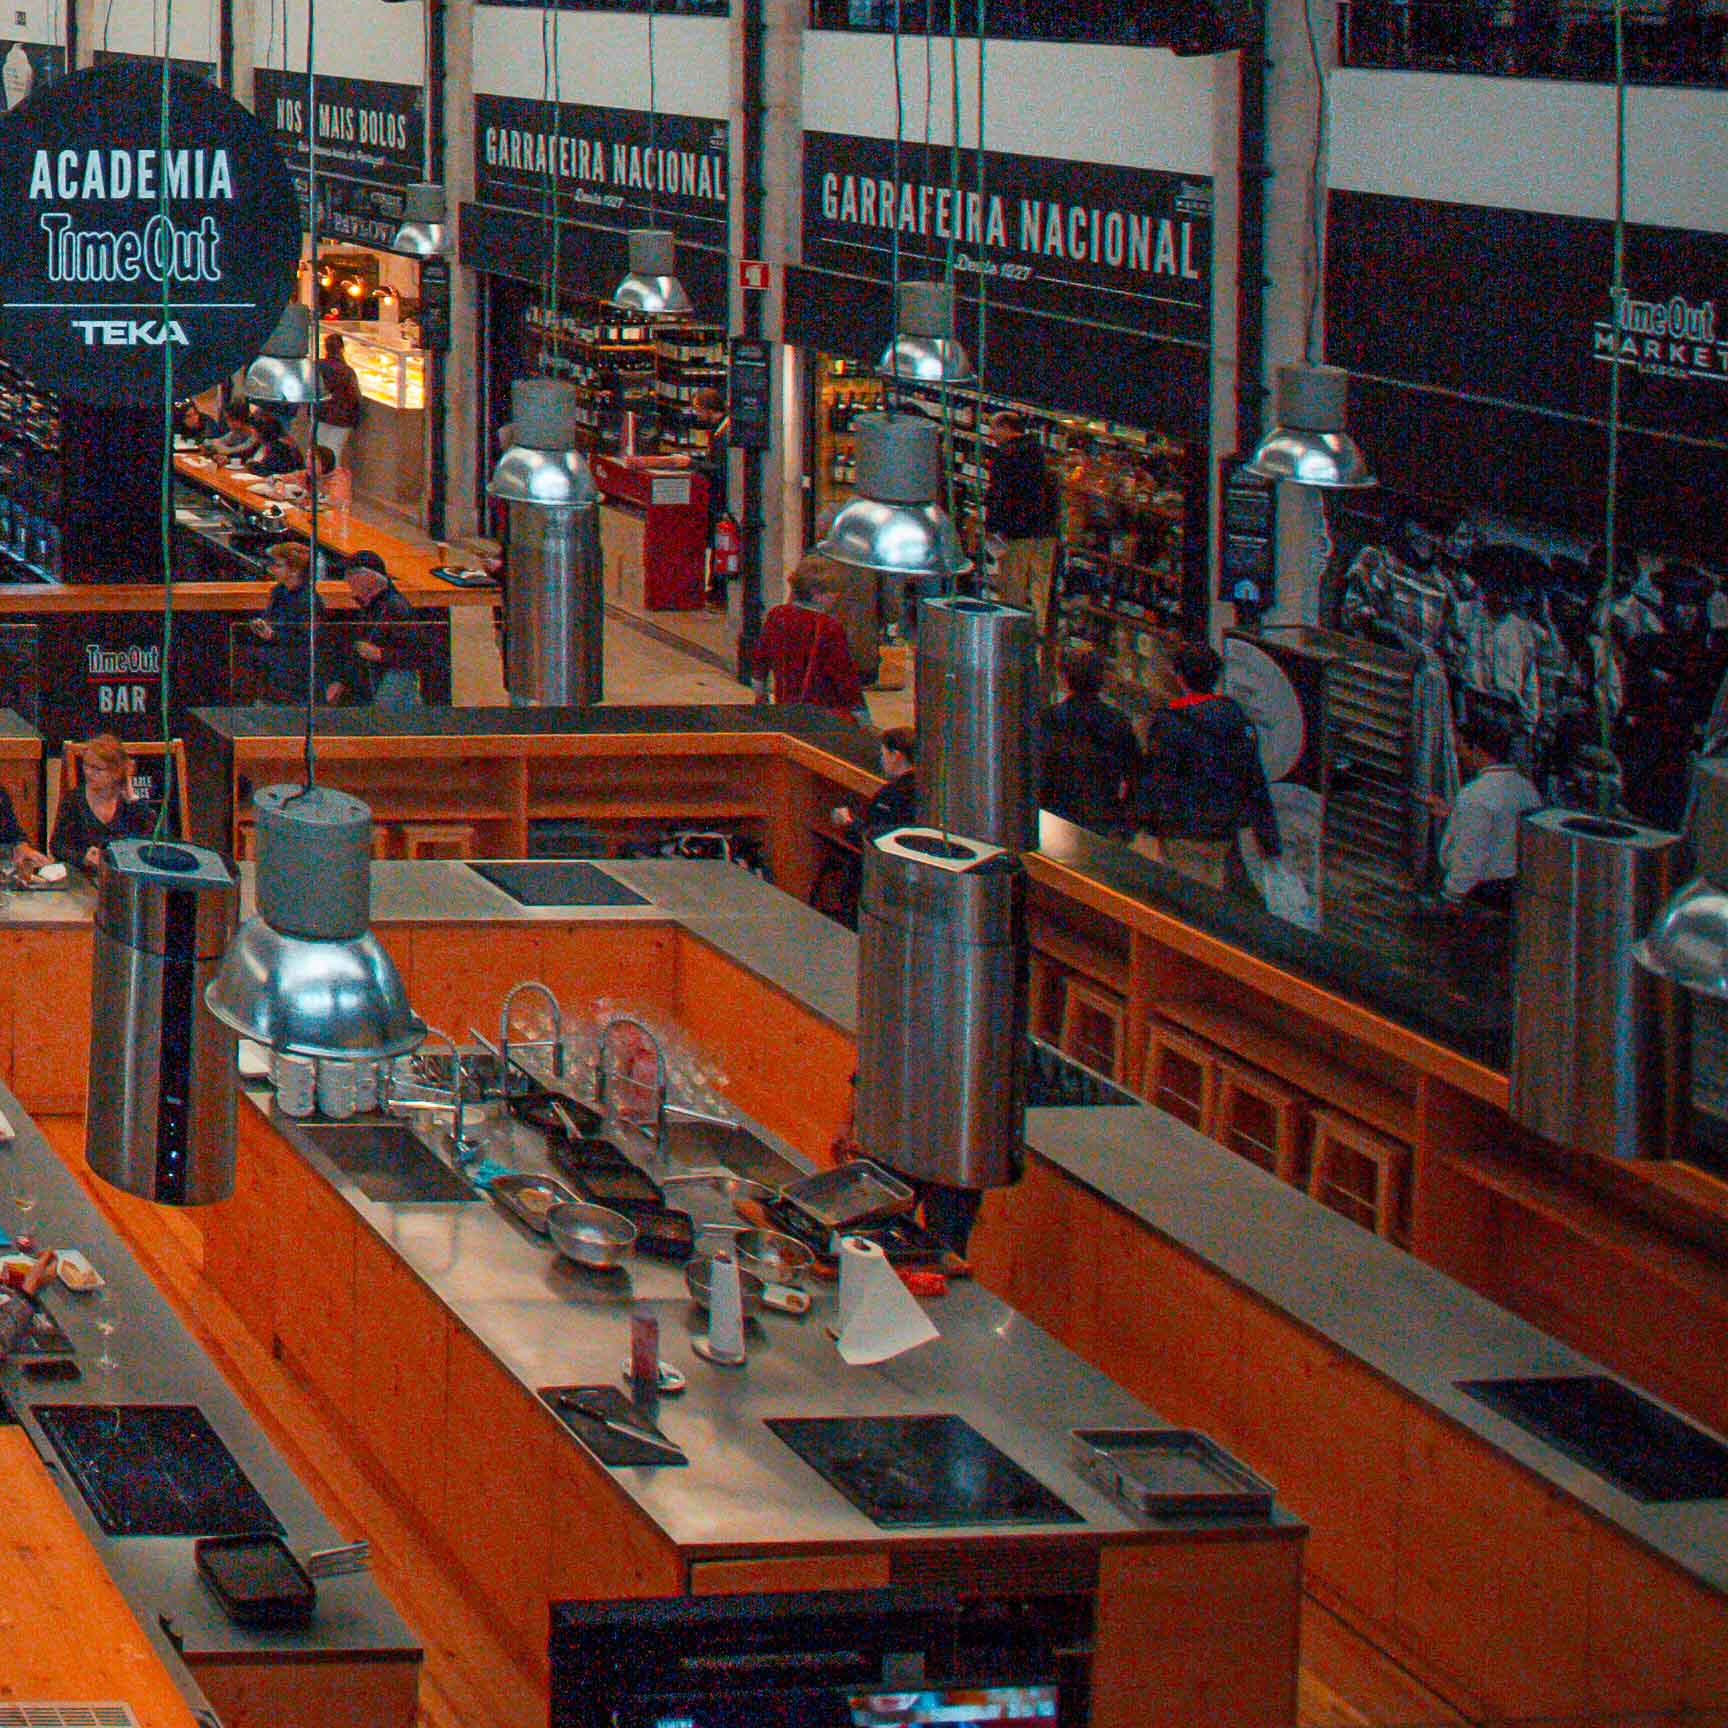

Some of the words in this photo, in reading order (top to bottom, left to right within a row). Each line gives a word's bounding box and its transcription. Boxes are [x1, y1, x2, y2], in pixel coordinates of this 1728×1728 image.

[319, 103, 355, 141] MAIS
[359, 108, 407, 150] BOLOS
[29, 150, 233, 199] ACADEMIA
[486, 127, 605, 182] GARRAFEIRA
[612, 142, 727, 203] NACIONAL
[41, 214, 141, 281] Time
[143, 214, 221, 281] Out
[822, 172, 1007, 250] GARRAFEIRA
[1020, 200, 1199, 280] NACIONAL
[73, 320, 189, 345] TEKA
[1595, 331, 1728, 372] MARKET
[86, 644, 128, 673] Time
[129, 646, 160, 673] Out
[99, 685, 146, 713] BAR
